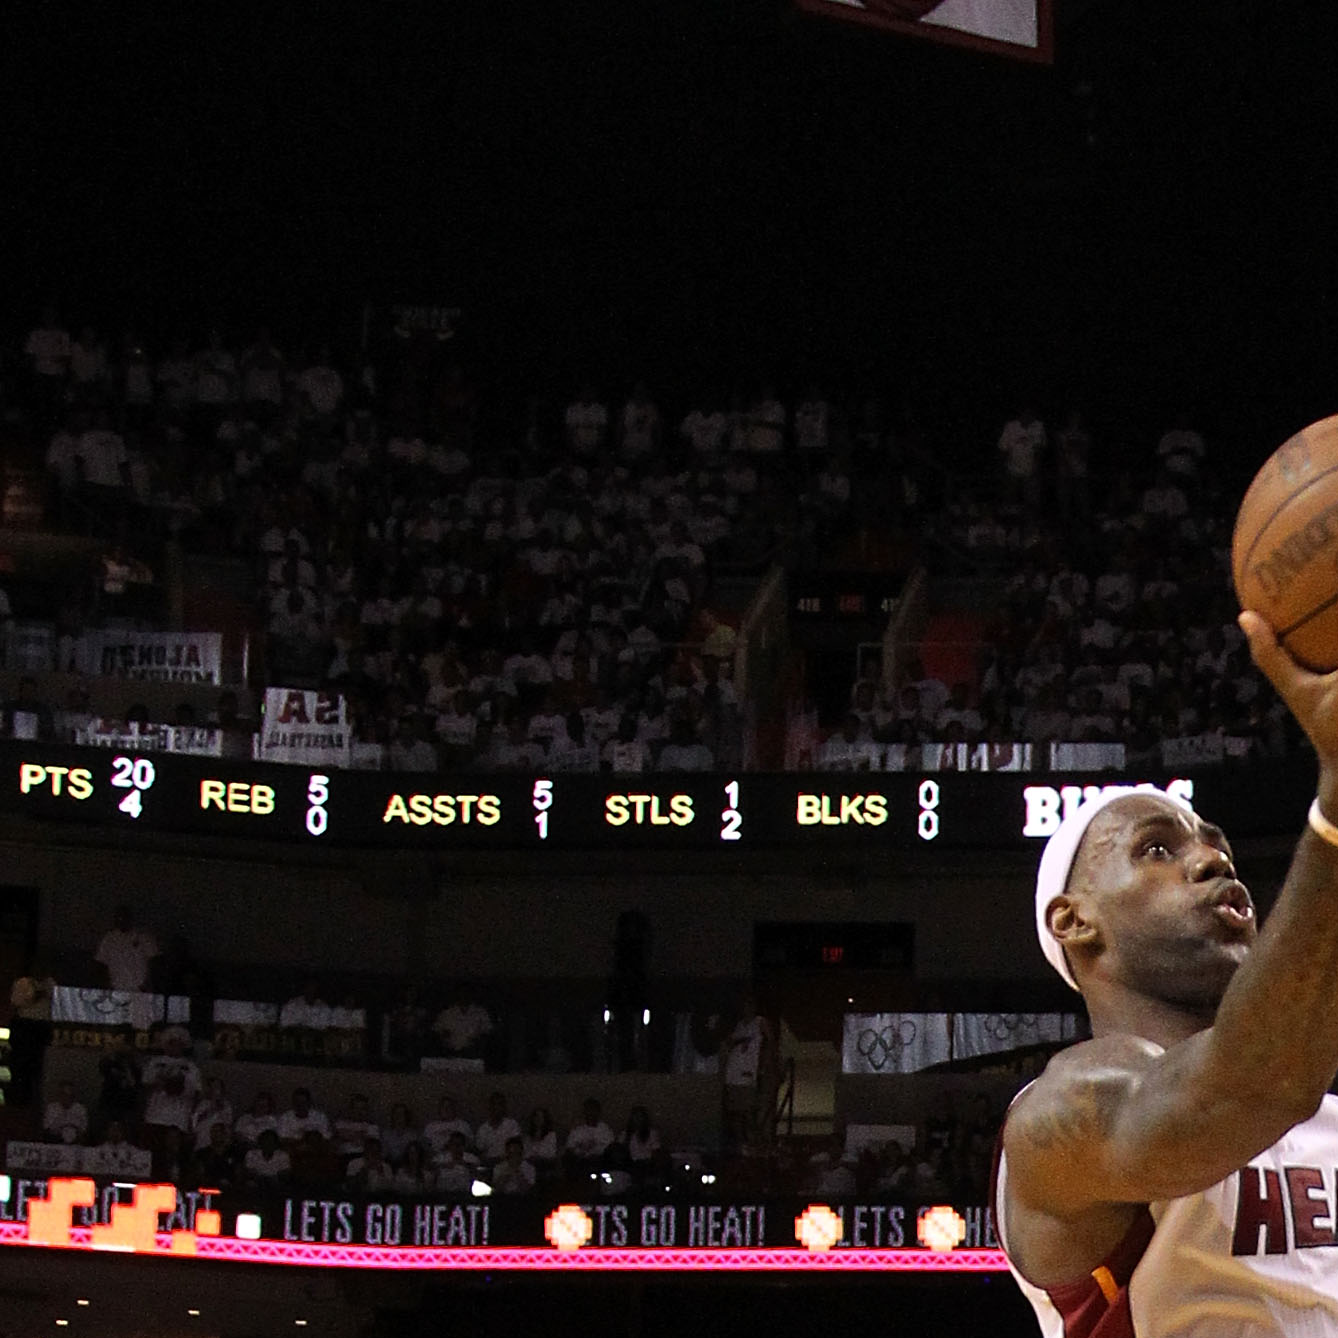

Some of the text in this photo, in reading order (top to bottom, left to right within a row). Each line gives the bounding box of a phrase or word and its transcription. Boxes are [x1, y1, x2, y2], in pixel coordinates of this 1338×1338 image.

[20, 756, 155, 800] PTS 20
[200, 774, 329, 815] REB 5
[118, 790, 142, 818] 4
[306, 805, 328, 836] 0
[383, 780, 554, 826] ASSTS 5
[605, 780, 740, 826] STLS 1
[796, 779, 940, 827] BLKS 0
[535, 811, 549, 840] 1
[720, 810, 743, 841] 2
[917, 810, 940, 841] 0
[283, 1198, 490, 1247] LETS GO HEAT!
[640, 1204, 676, 1247] GO
[688, 1204, 766, 1248] HEAT!
